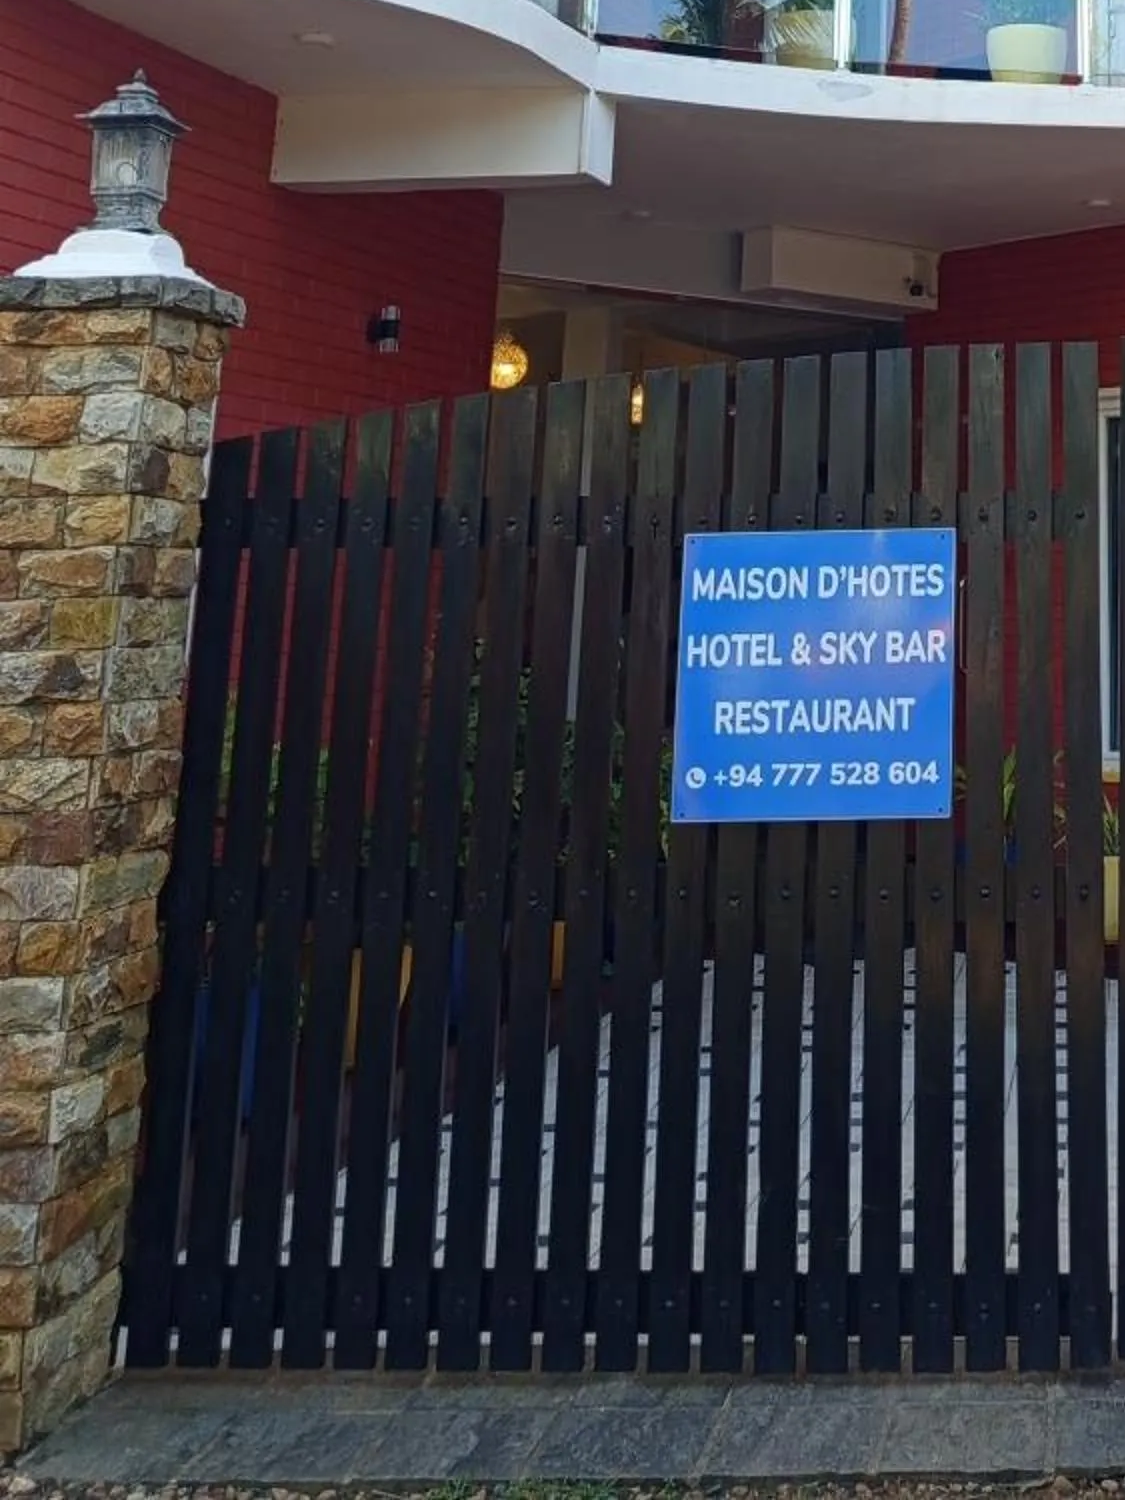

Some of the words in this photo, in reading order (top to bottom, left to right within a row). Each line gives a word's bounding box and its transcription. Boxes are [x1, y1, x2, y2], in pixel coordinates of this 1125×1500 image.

[693, 566, 808, 600] MAISON
[687, 633, 782, 668] HOTEL
[791, 632, 811, 666] &
[819, 631, 878, 665] SKY
[885, 629, 946, 663] BAR
[715, 697, 916, 735] RESTAURANT
[714, 764, 763, 787] +94
[771, 763, 821, 786] 777
[830, 762, 880, 785] 528
[888, 761, 939, 785] 604
